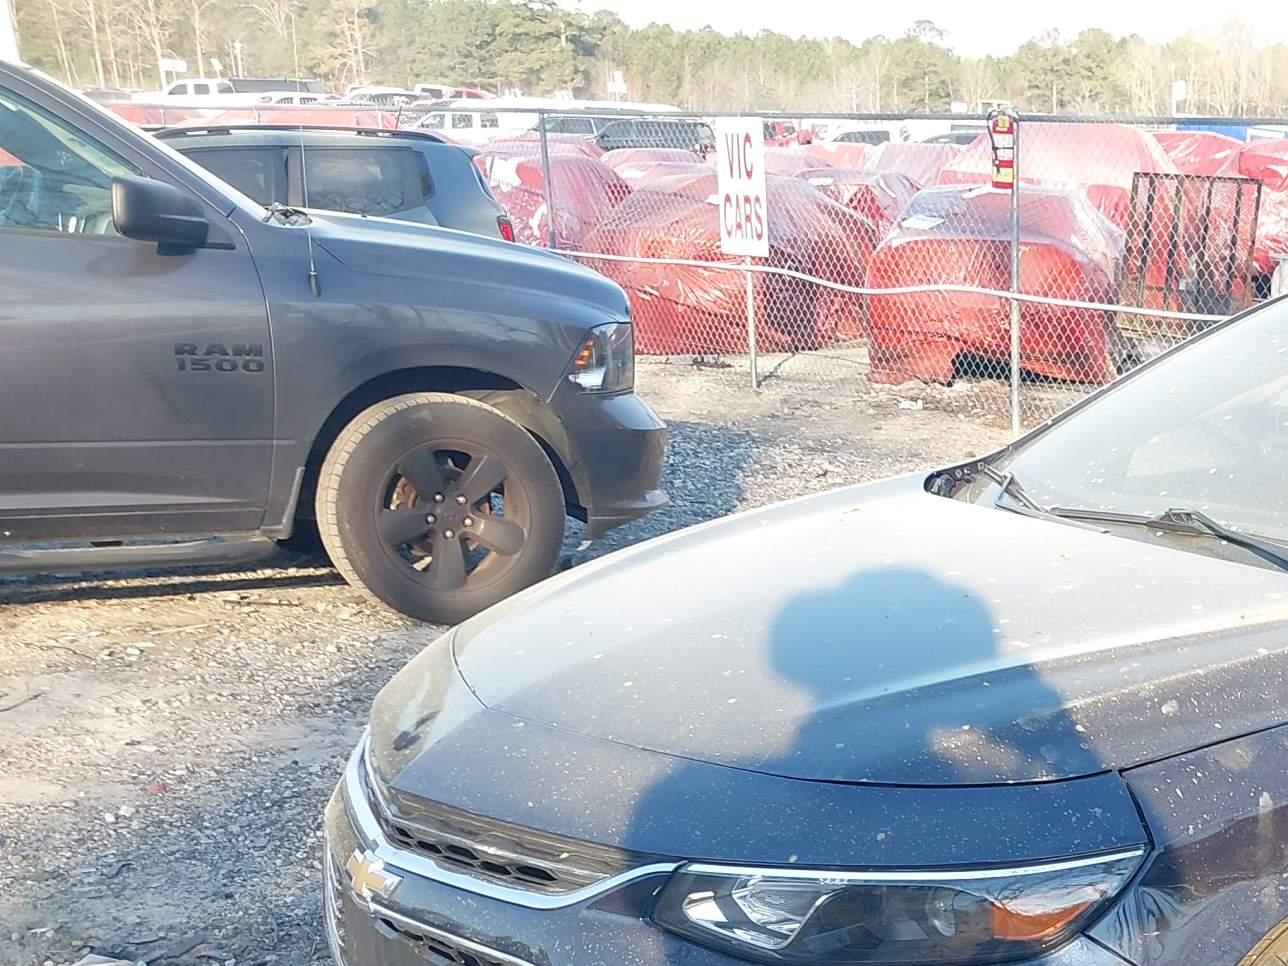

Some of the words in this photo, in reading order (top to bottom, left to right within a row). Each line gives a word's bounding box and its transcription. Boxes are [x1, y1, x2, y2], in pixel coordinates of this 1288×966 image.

[725, 132, 753, 180] VIC
[724, 193, 763, 241] CARS
[174, 342, 264, 357] RAM
[175, 356, 265, 373] 1500
